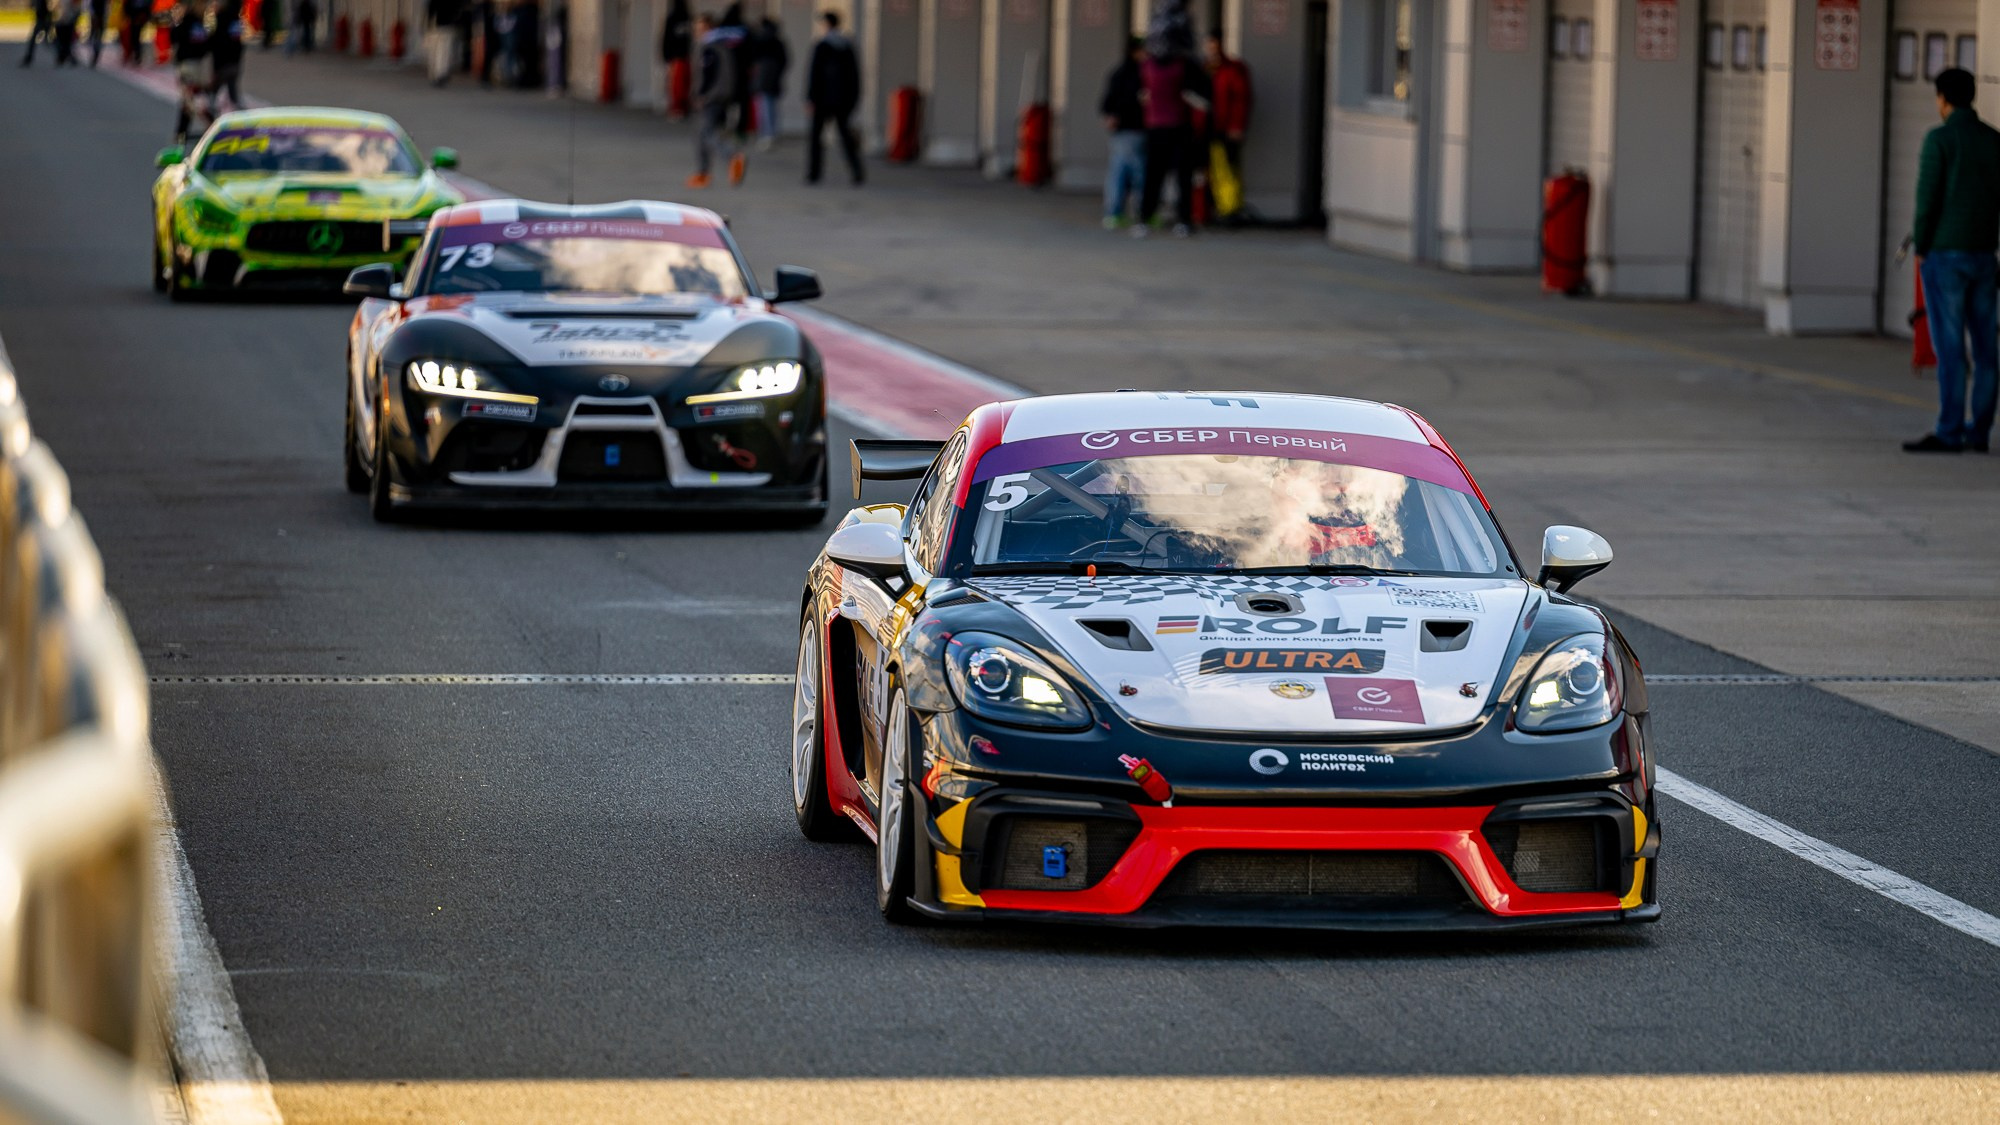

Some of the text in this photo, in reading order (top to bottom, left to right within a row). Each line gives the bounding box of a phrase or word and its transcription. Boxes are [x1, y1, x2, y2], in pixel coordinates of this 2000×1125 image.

[531, 221, 588, 235] СБЕР
[440, 242, 495, 272] 73
[1129, 430, 1347, 452] СБЕР Первый
[984, 472, 1031, 512] 5
[1201, 615, 1408, 635] ROLF
[1292, 635, 1384, 643] Kompromisse
[1223, 651, 1364, 669] ULTRA
